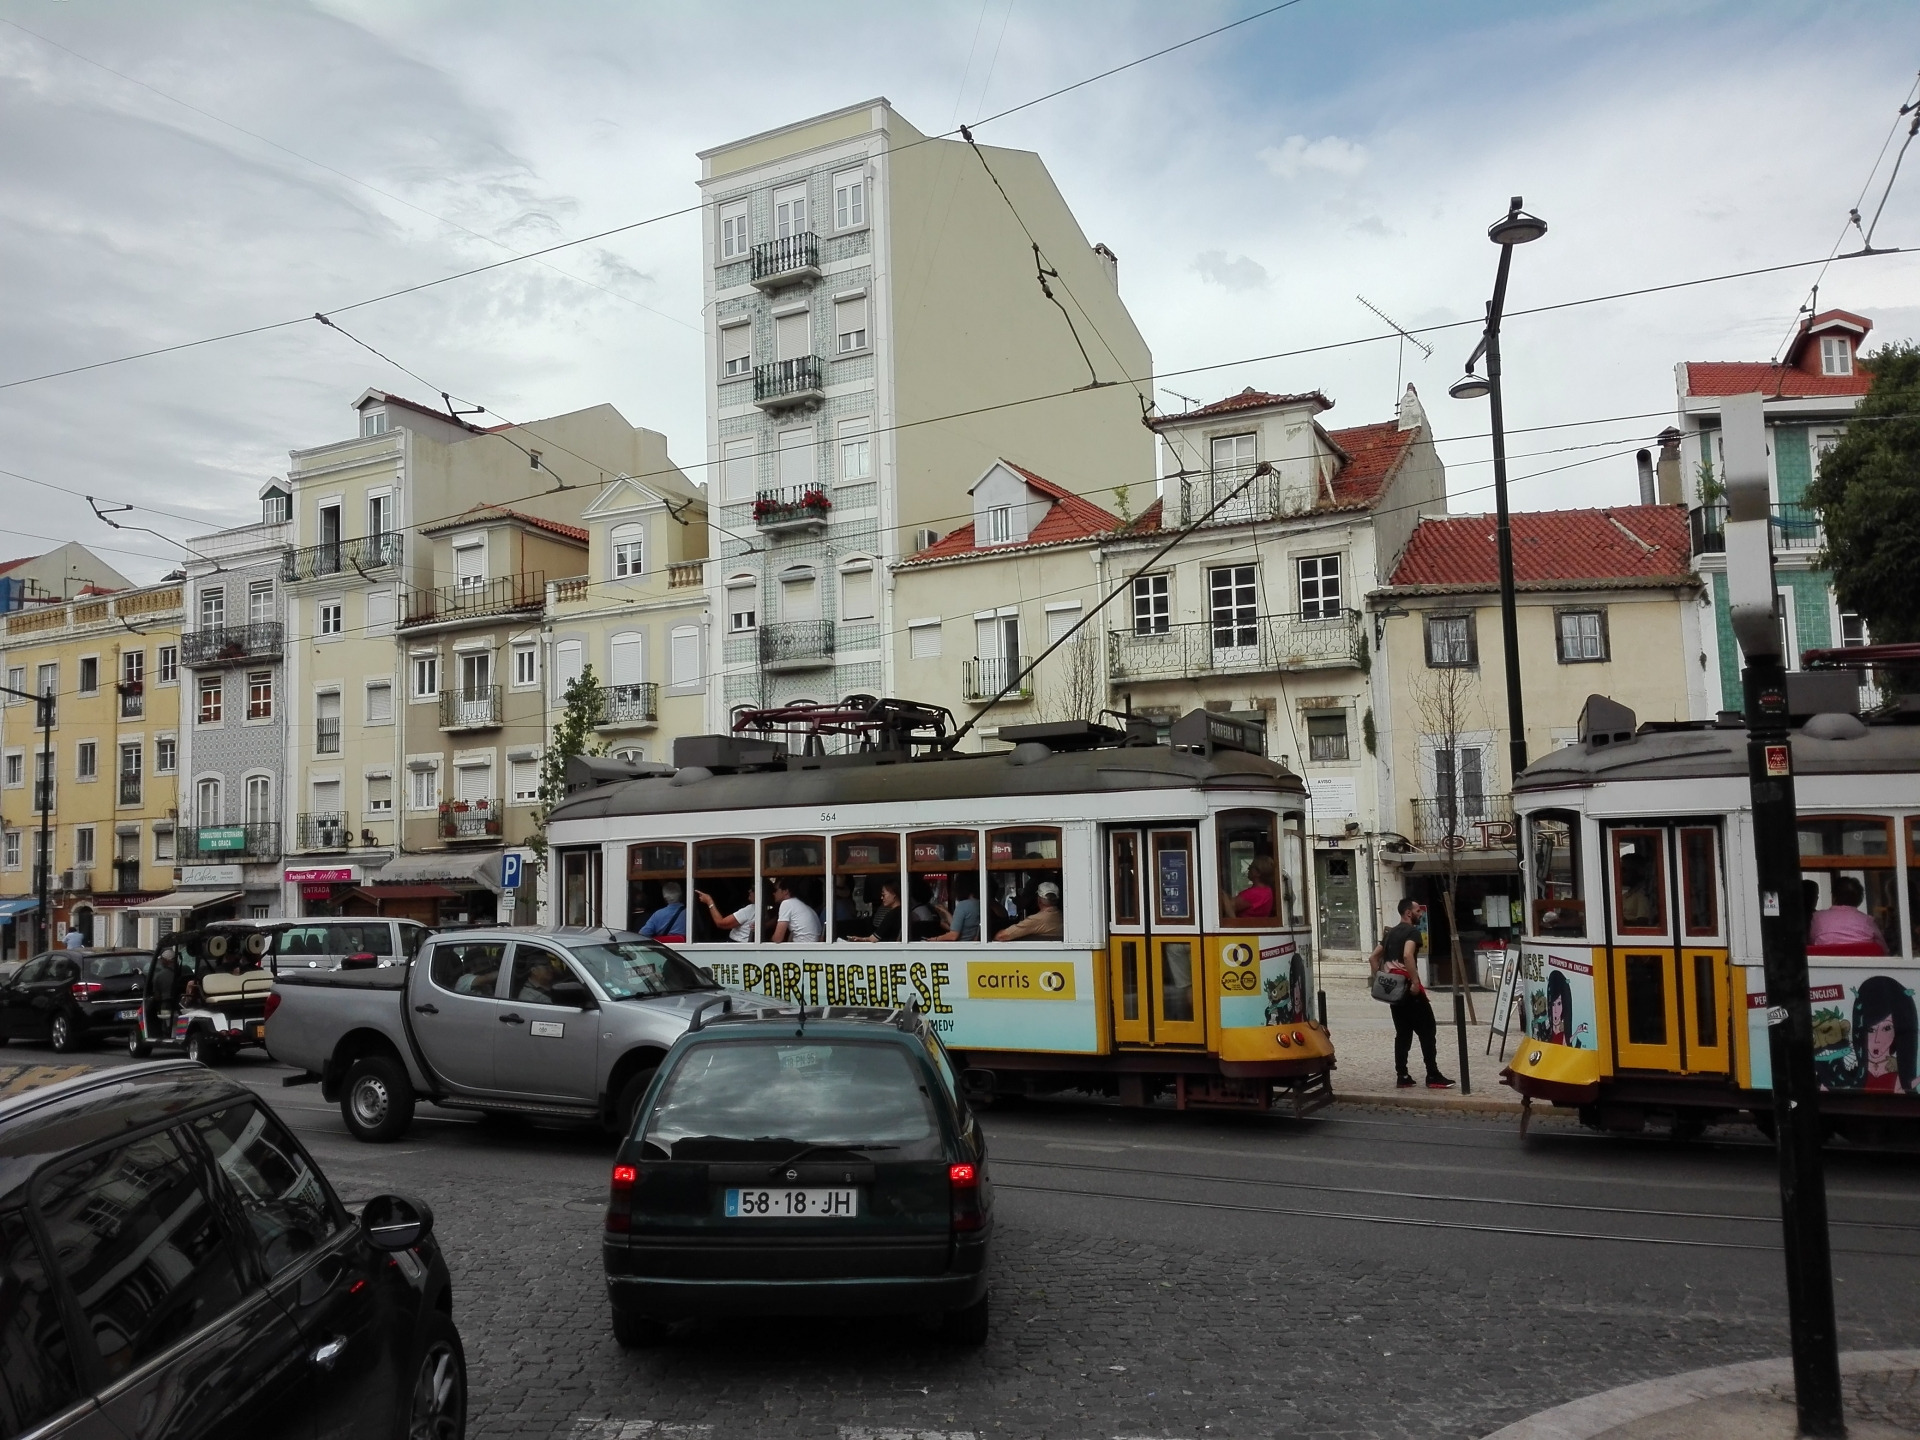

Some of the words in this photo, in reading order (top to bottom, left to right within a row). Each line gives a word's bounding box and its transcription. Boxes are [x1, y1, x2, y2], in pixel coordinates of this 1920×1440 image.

[820, 812, 836, 822] 564
[218, 840, 231, 848] GRAÇA
[504, 856, 517, 885] P
[1550, 957, 1567, 968] PERFORMED
[1573, 963, 1589, 973] ENGLISH
[711, 963, 739, 985] THE
[977, 969, 1030, 988] carris
